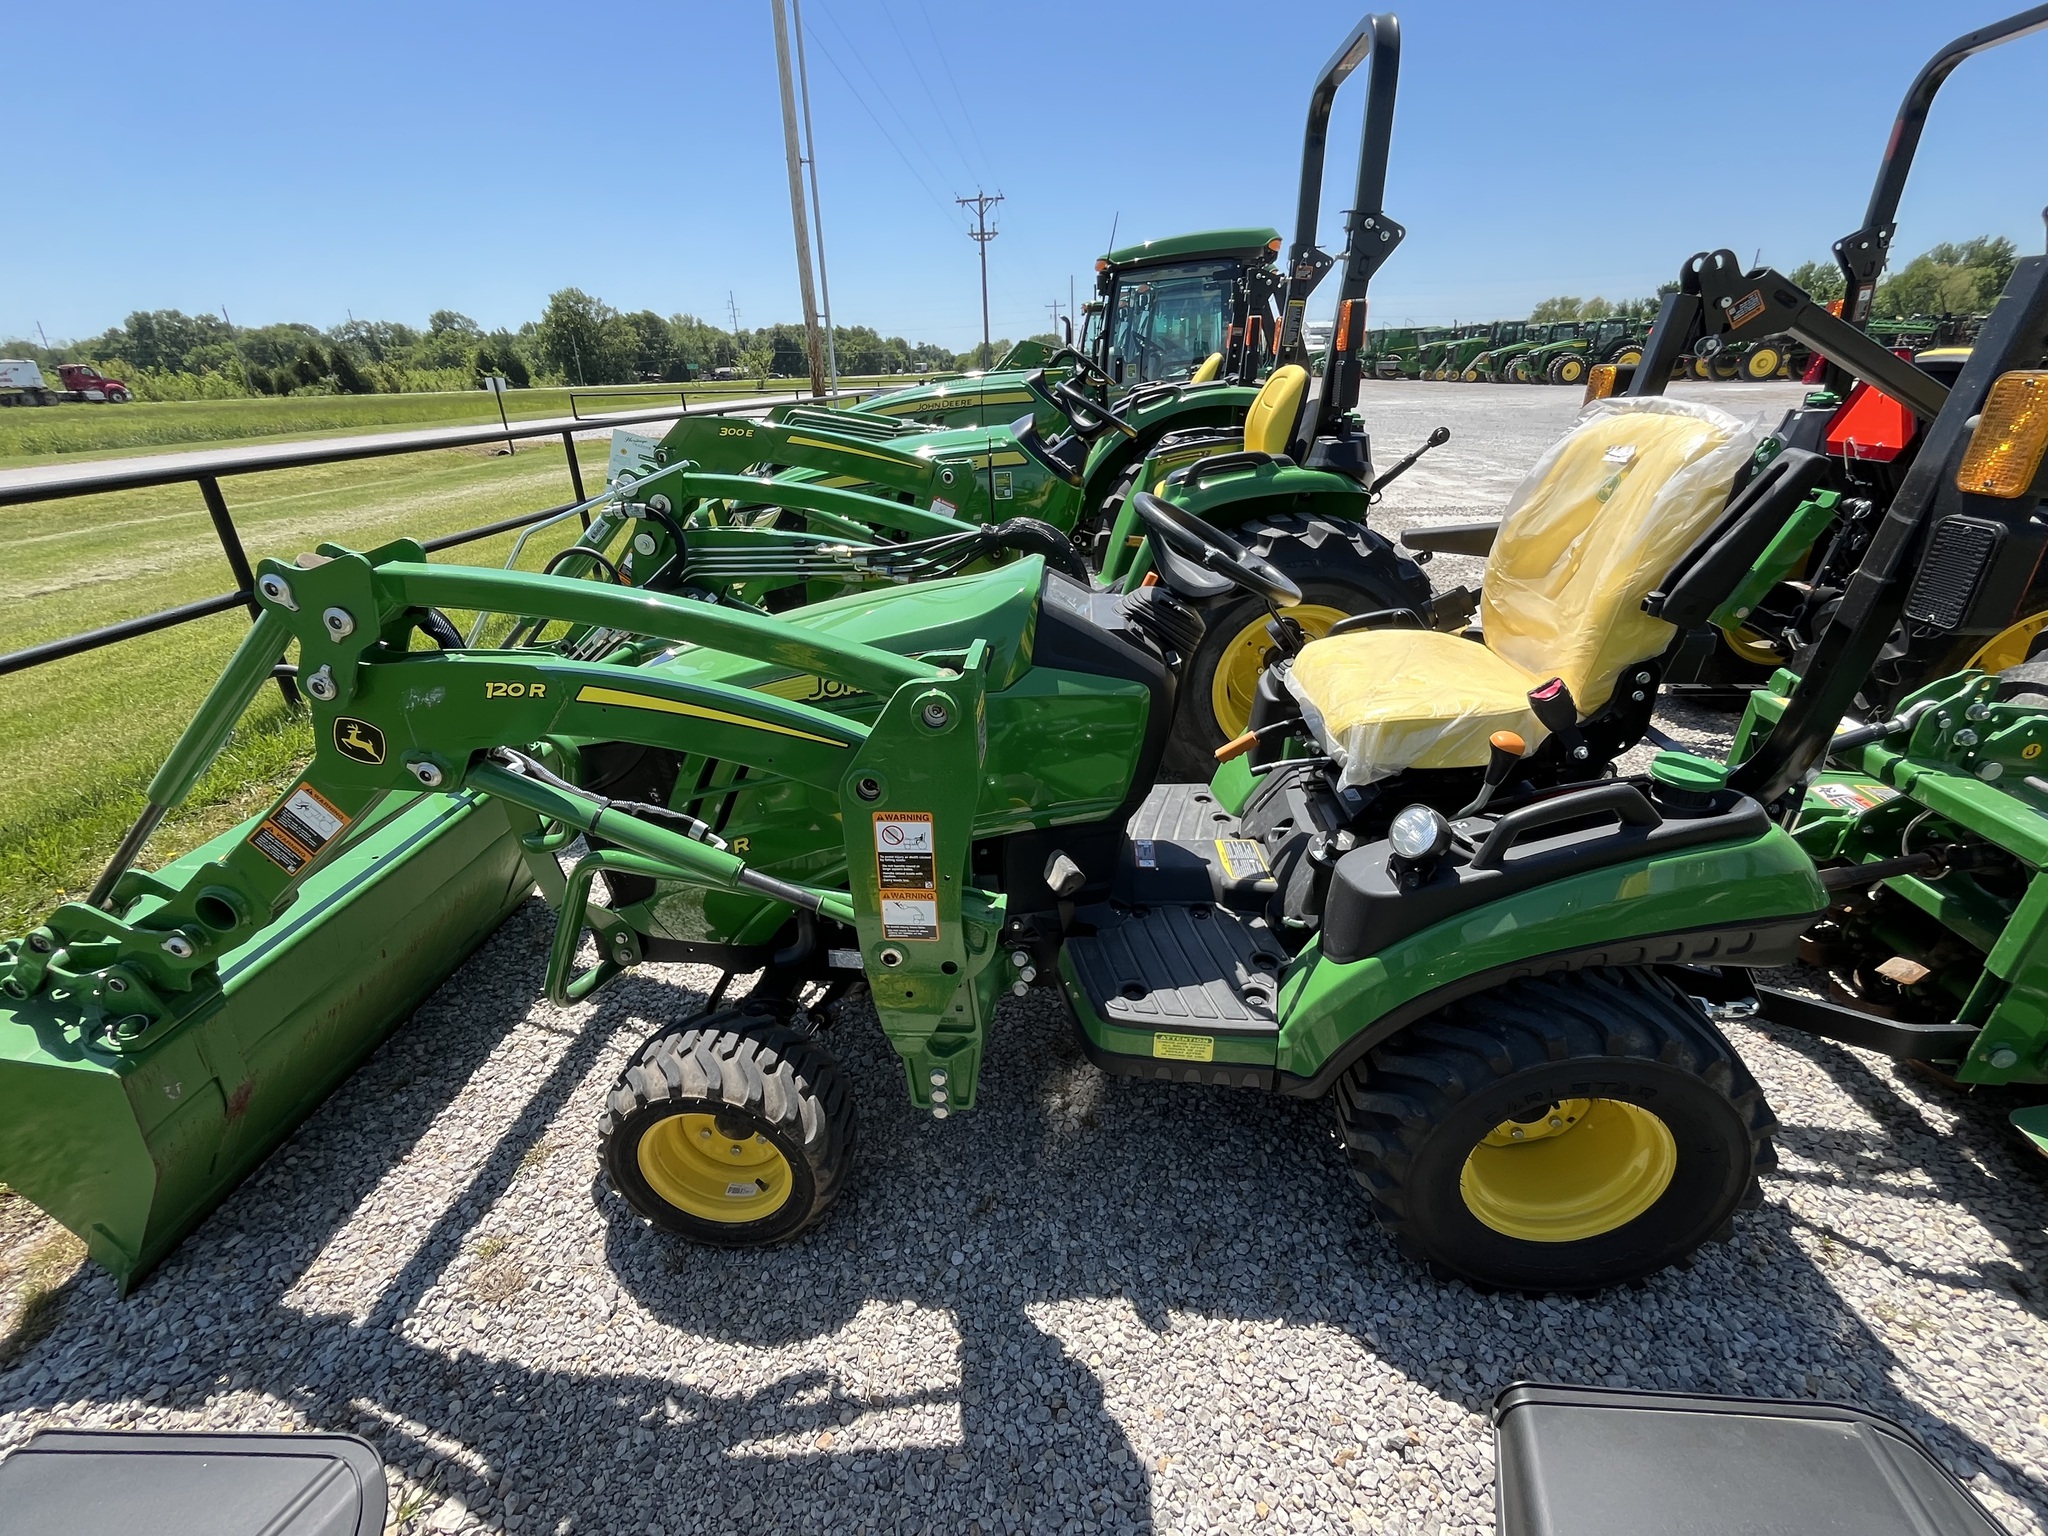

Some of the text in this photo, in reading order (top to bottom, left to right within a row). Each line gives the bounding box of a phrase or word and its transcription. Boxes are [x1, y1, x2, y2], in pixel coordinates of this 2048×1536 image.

[917, 399, 973, 411] JOHN DEERE
[314, 794, 344, 821] WARNING
[884, 813, 930, 822] WARNING
[276, 832, 306, 858] WARNING
[890, 892, 934, 900] WARNING
[1159, 1035, 1209, 1044] ATTENTION
